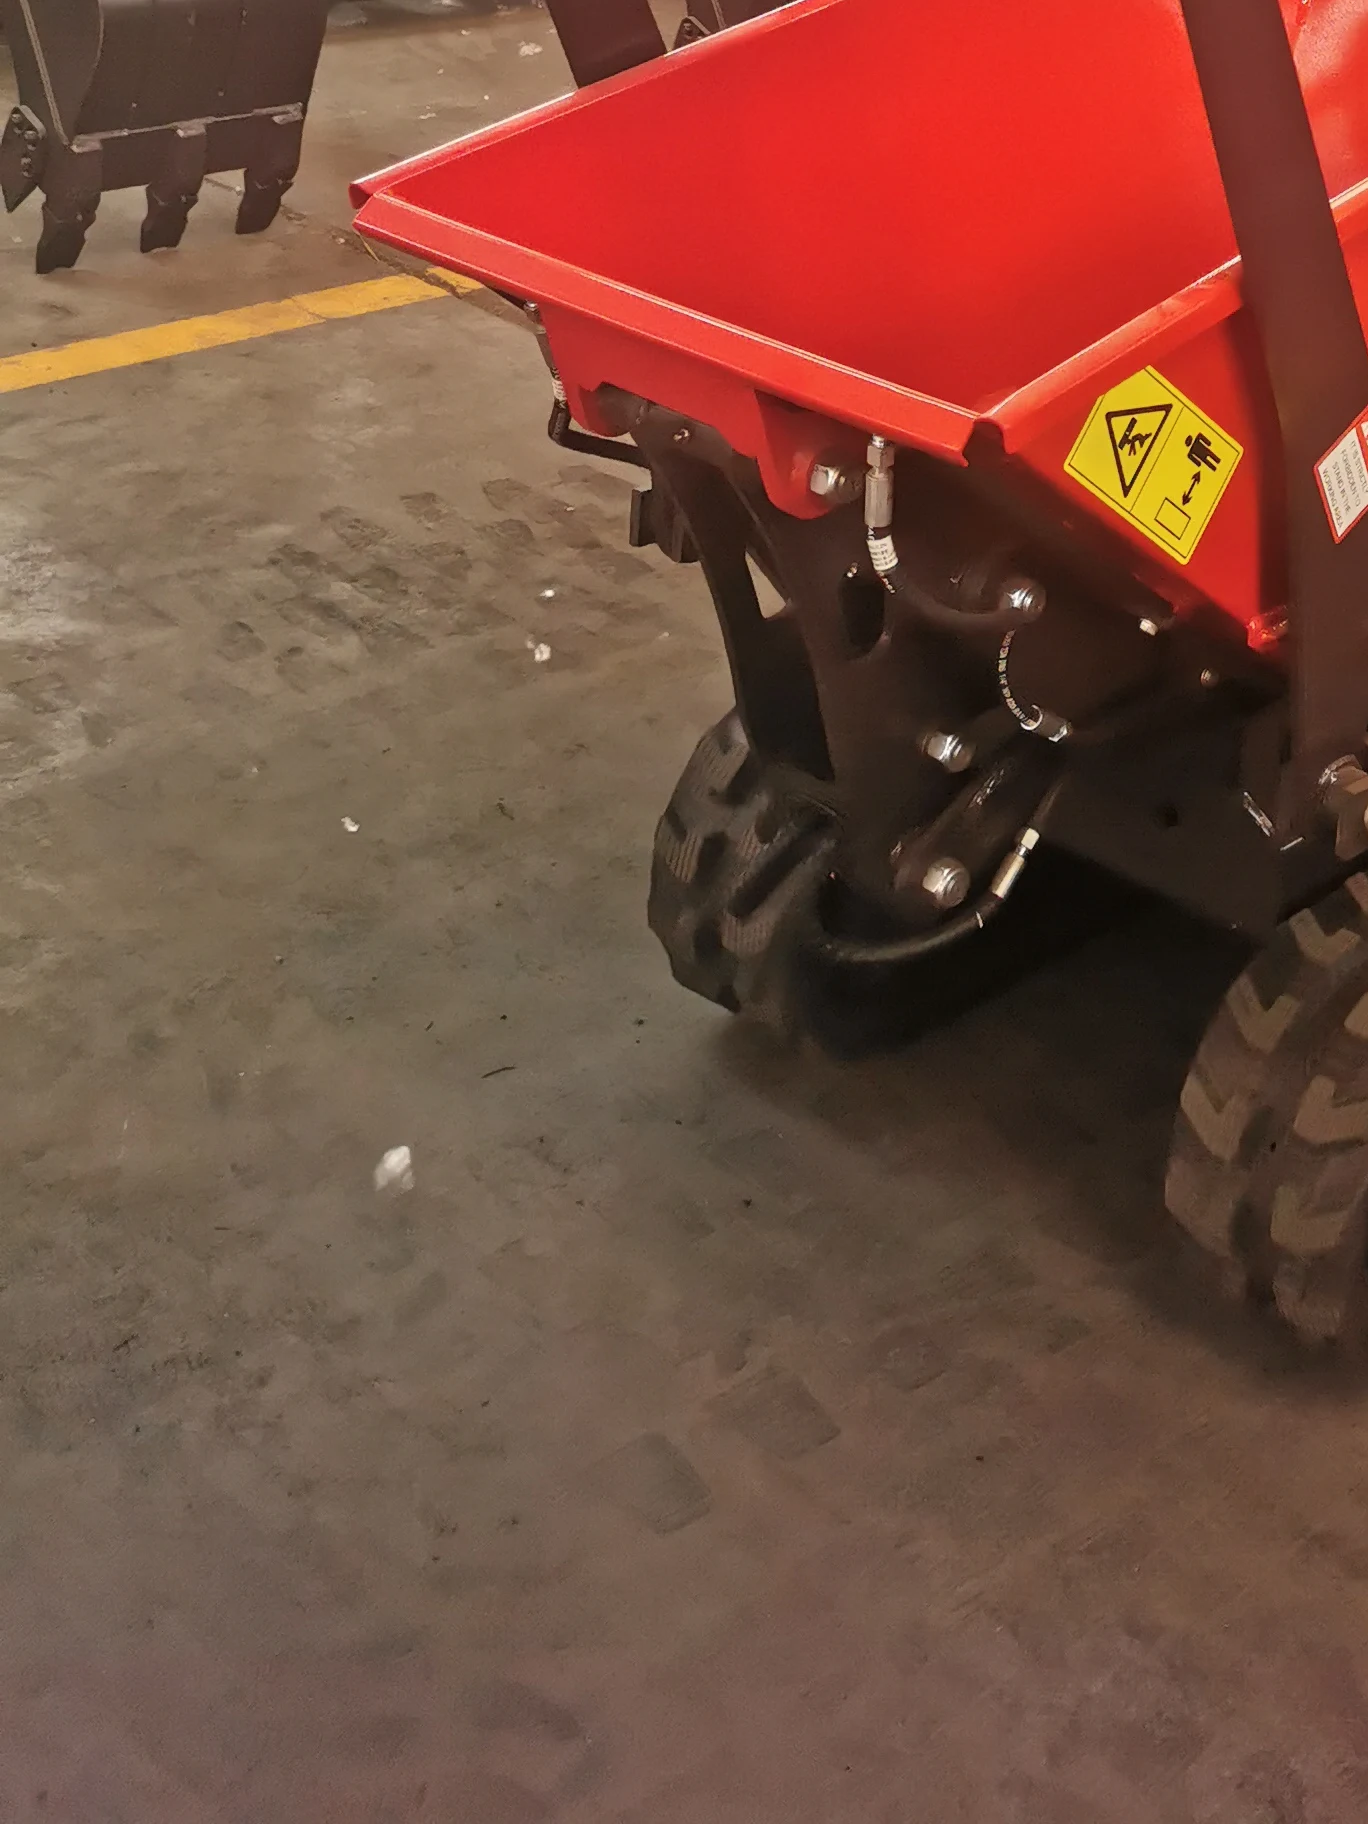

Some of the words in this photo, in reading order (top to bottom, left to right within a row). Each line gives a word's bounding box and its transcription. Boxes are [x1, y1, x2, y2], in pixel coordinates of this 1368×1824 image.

[1322, 468, 1337, 507] WORKING
[1333, 505, 1344, 529] AREA
[1332, 462, 1343, 490] STAND
[1341, 495, 1351, 515] THE
[1340, 449, 1357, 496] FORBIDDEN
